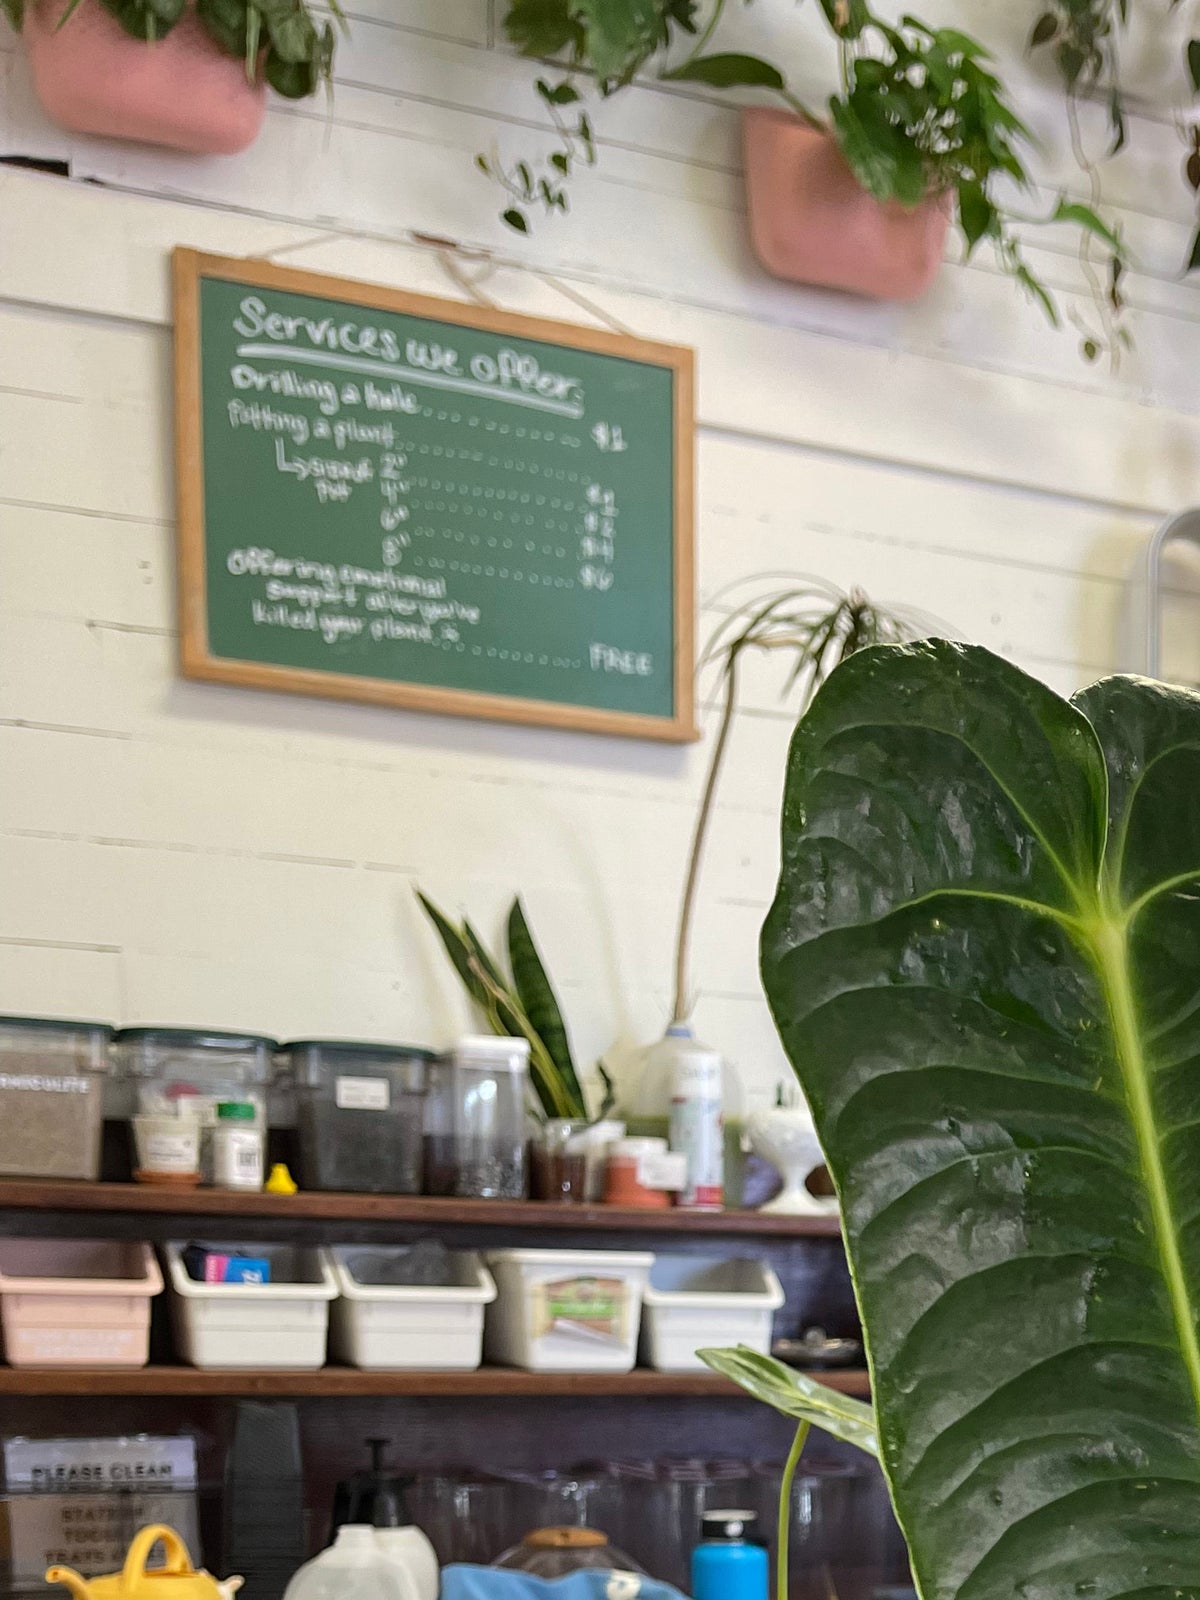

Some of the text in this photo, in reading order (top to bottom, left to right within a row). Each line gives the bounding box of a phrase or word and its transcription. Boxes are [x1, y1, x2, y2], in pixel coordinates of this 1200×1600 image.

[233, 296, 401, 362] Services
[405, 338, 463, 376] we
[231, 363, 340, 415] Drilling
[341, 383, 361, 404] a
[364, 380, 421, 414] hole
[227, 398, 397, 449] Potting a plant
